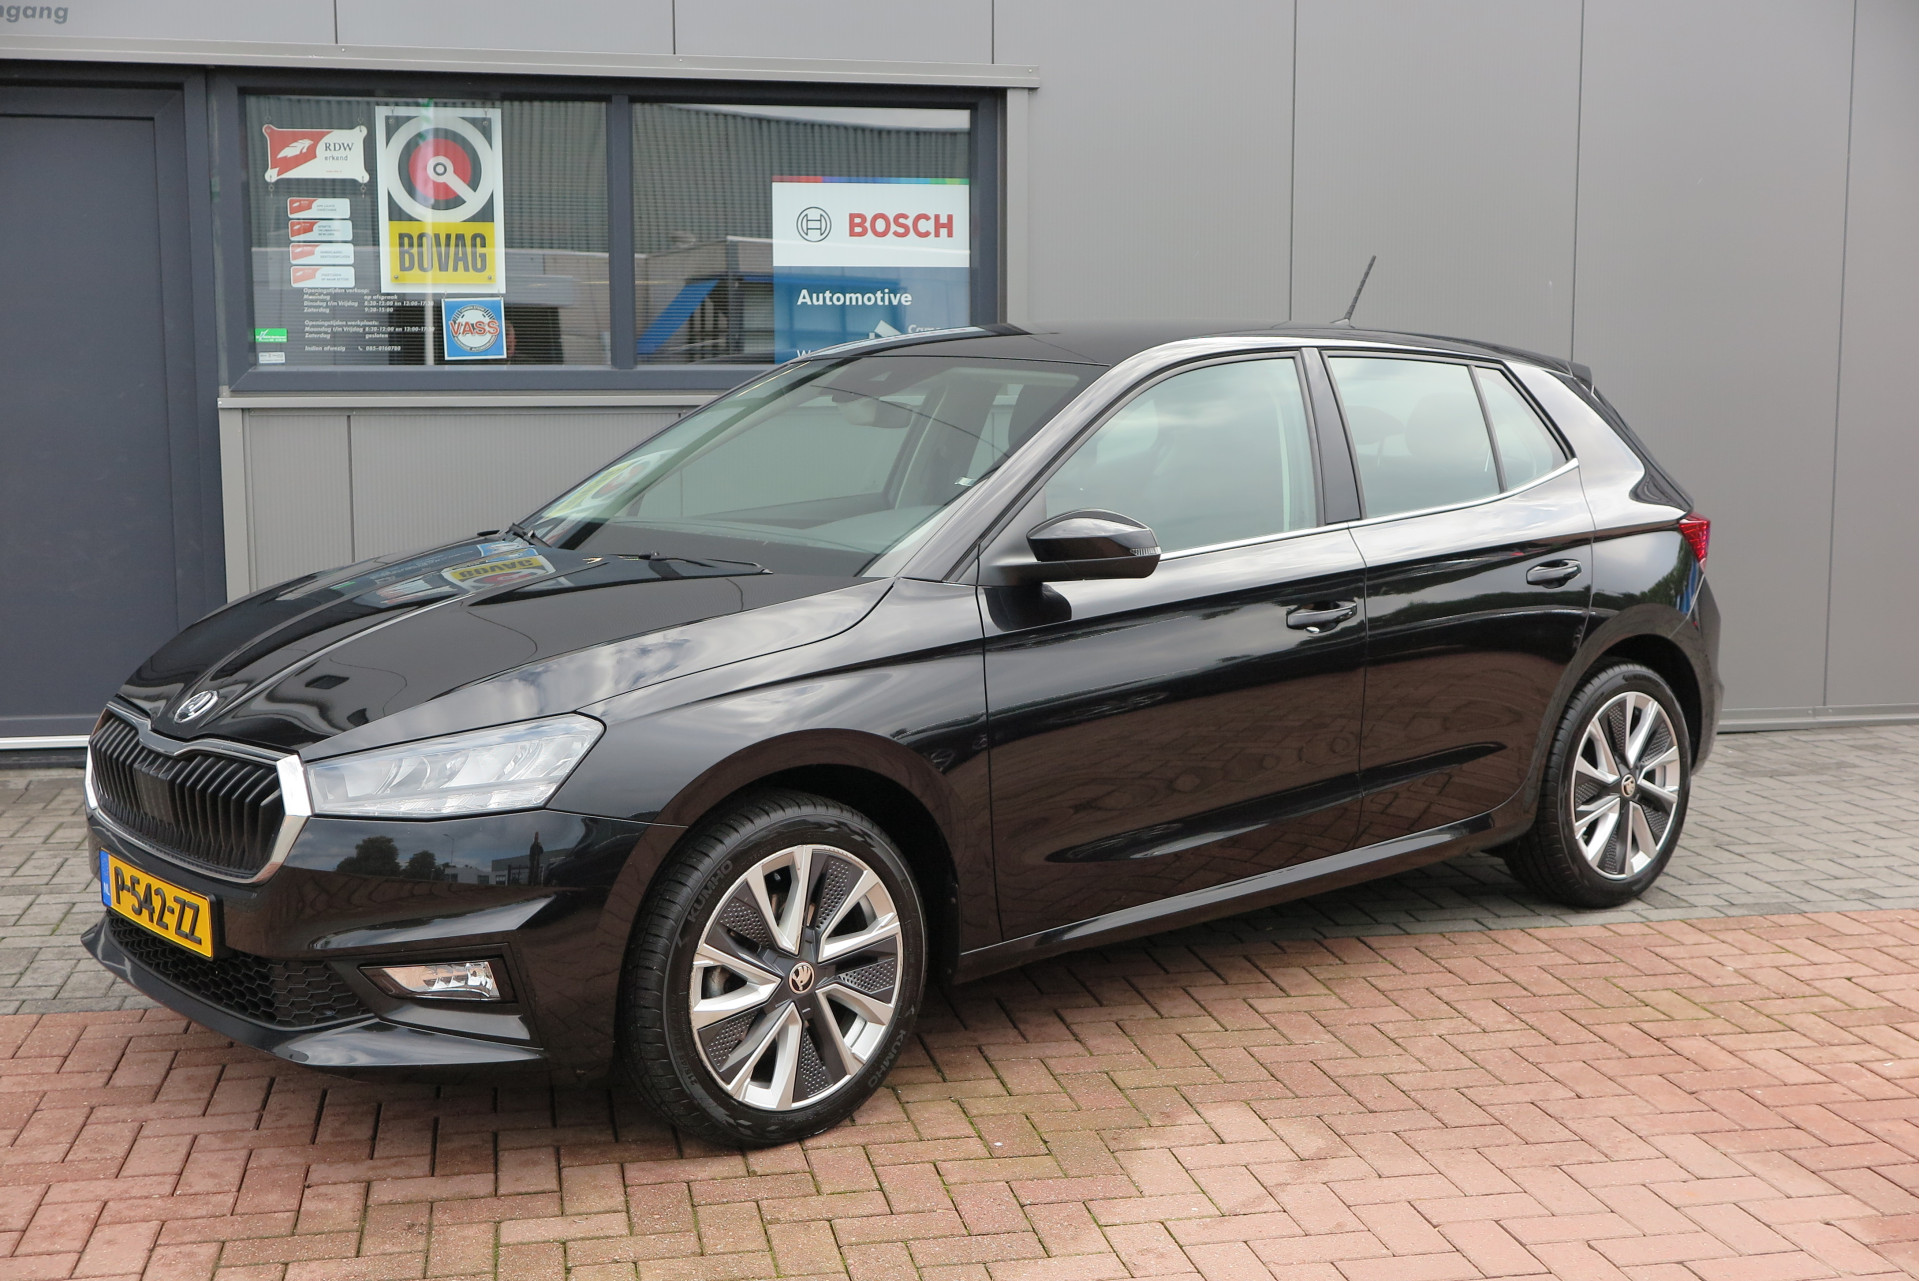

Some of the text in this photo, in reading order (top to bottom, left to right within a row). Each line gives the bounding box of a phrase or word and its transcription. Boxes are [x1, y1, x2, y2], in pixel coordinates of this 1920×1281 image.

[324, 142, 354, 152] RDW
[848, 212, 954, 239] BOSCH
[397, 232, 487, 273] BOVAG
[796, 288, 913, 306] Automotive
[449, 319, 500, 337] VASS
[114, 866, 202, 946] P-542-ZZ
[687, 860, 733, 922] KUMHO
[868, 1029, 906, 1088] KUMHO
